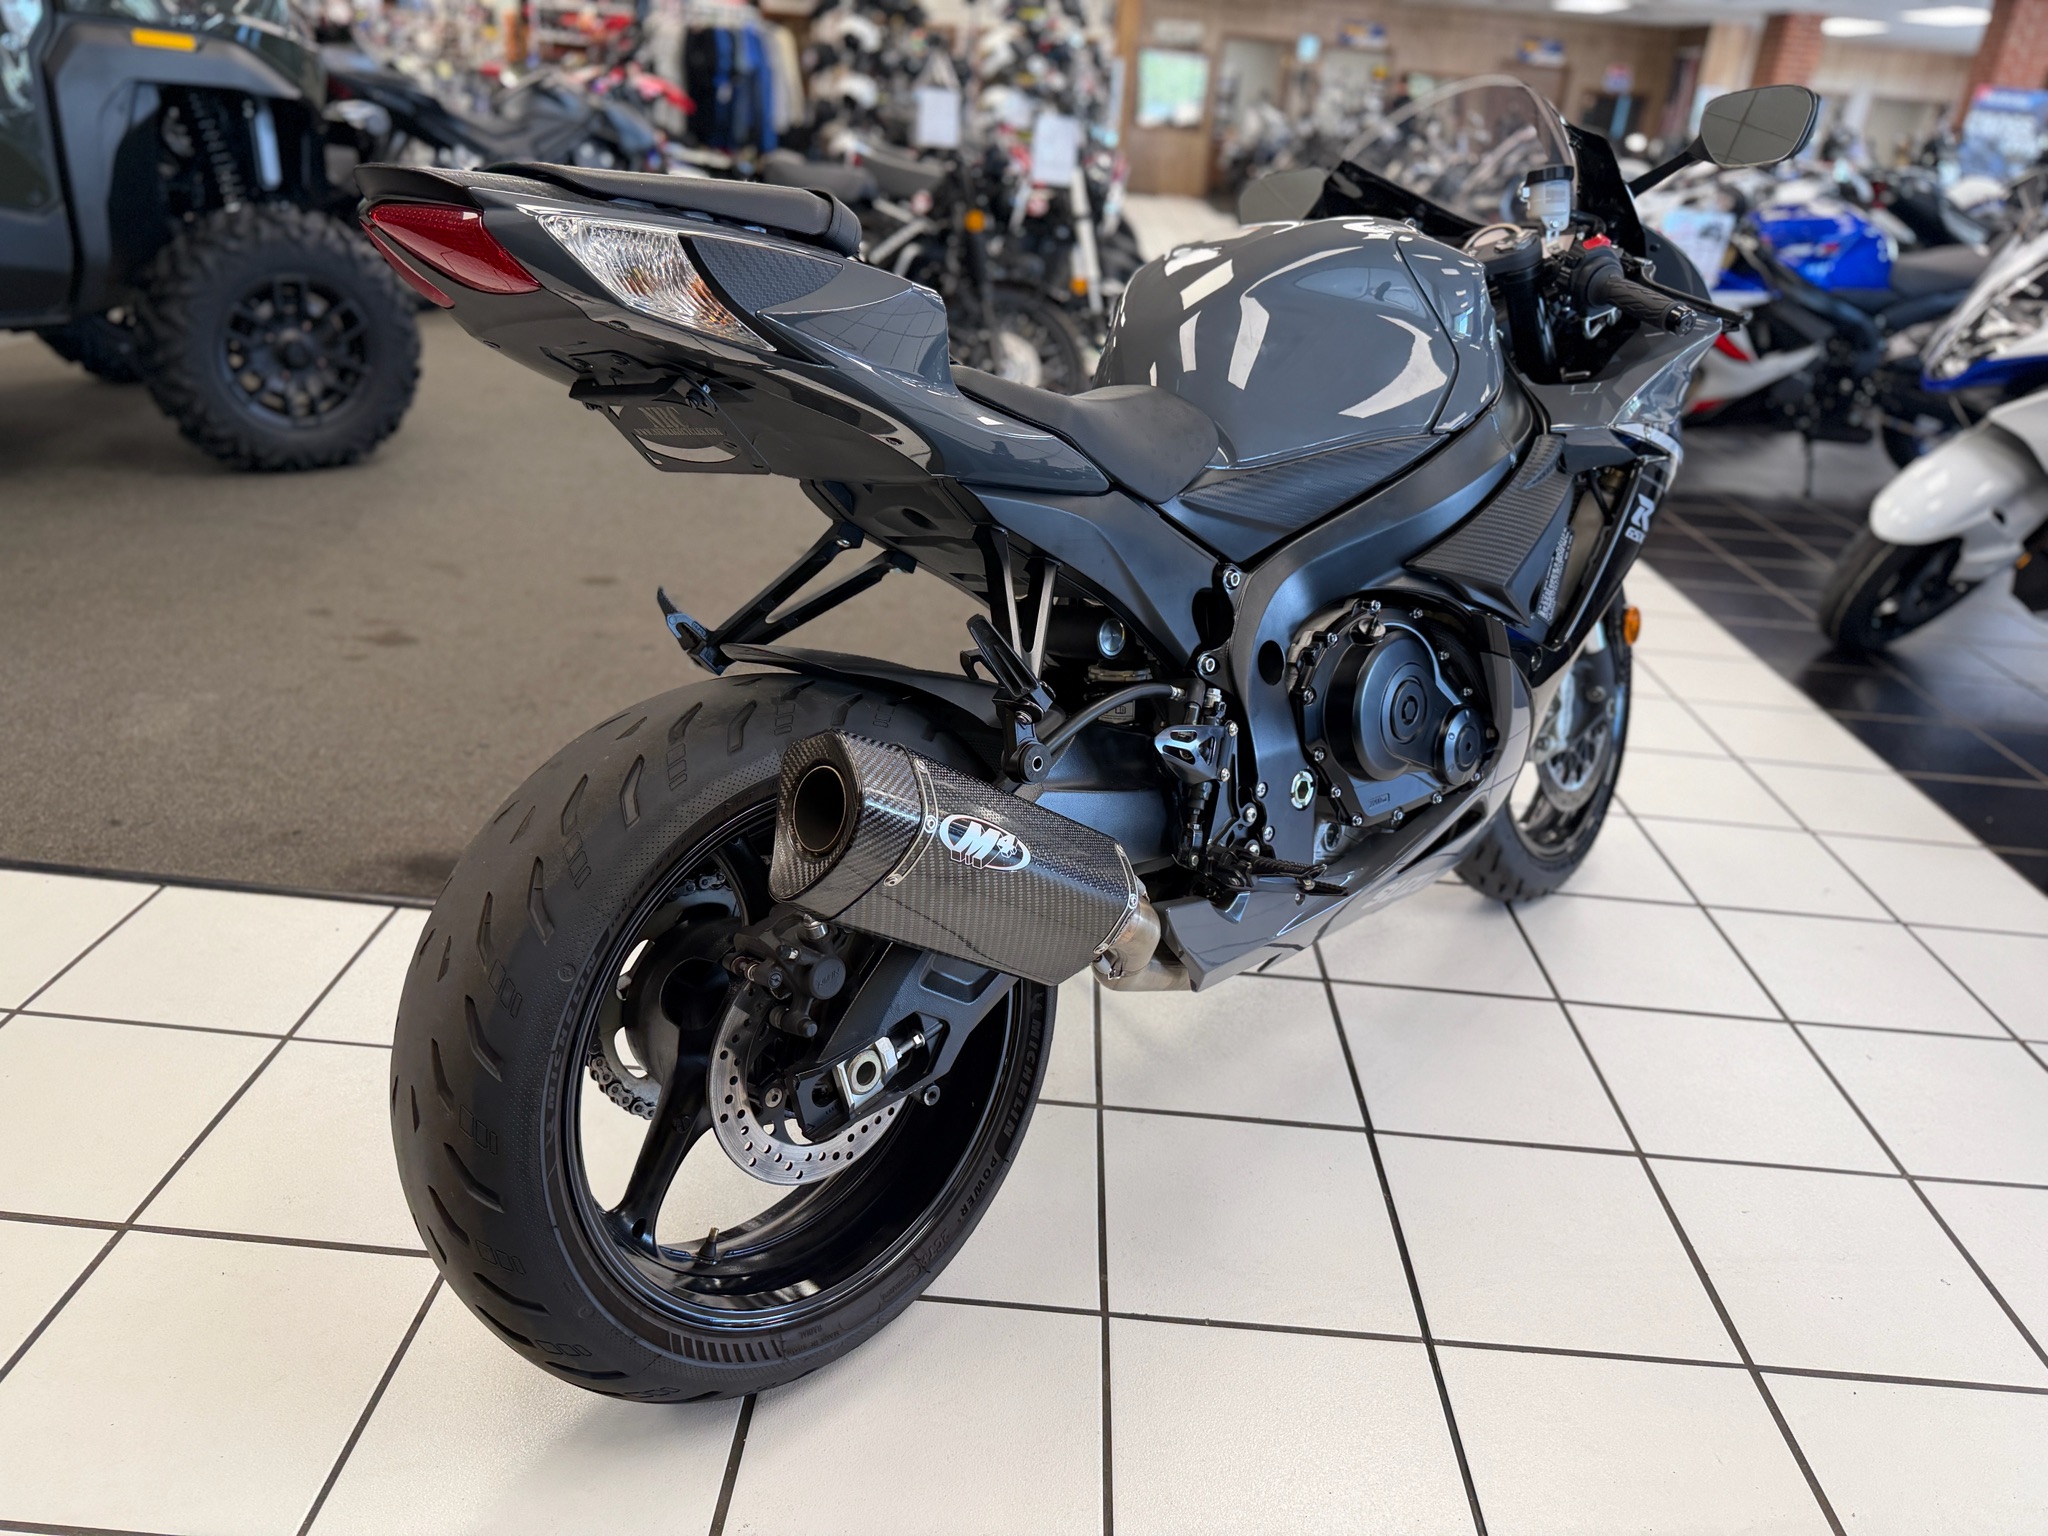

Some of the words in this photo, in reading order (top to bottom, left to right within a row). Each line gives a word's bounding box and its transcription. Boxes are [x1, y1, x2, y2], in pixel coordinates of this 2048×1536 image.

[950, 820, 1019, 869] M4
[547, 953, 597, 1110] MICHELIN
[1003, 1018, 1042, 1140] MICHELIN
[960, 1155, 998, 1217] POWER
